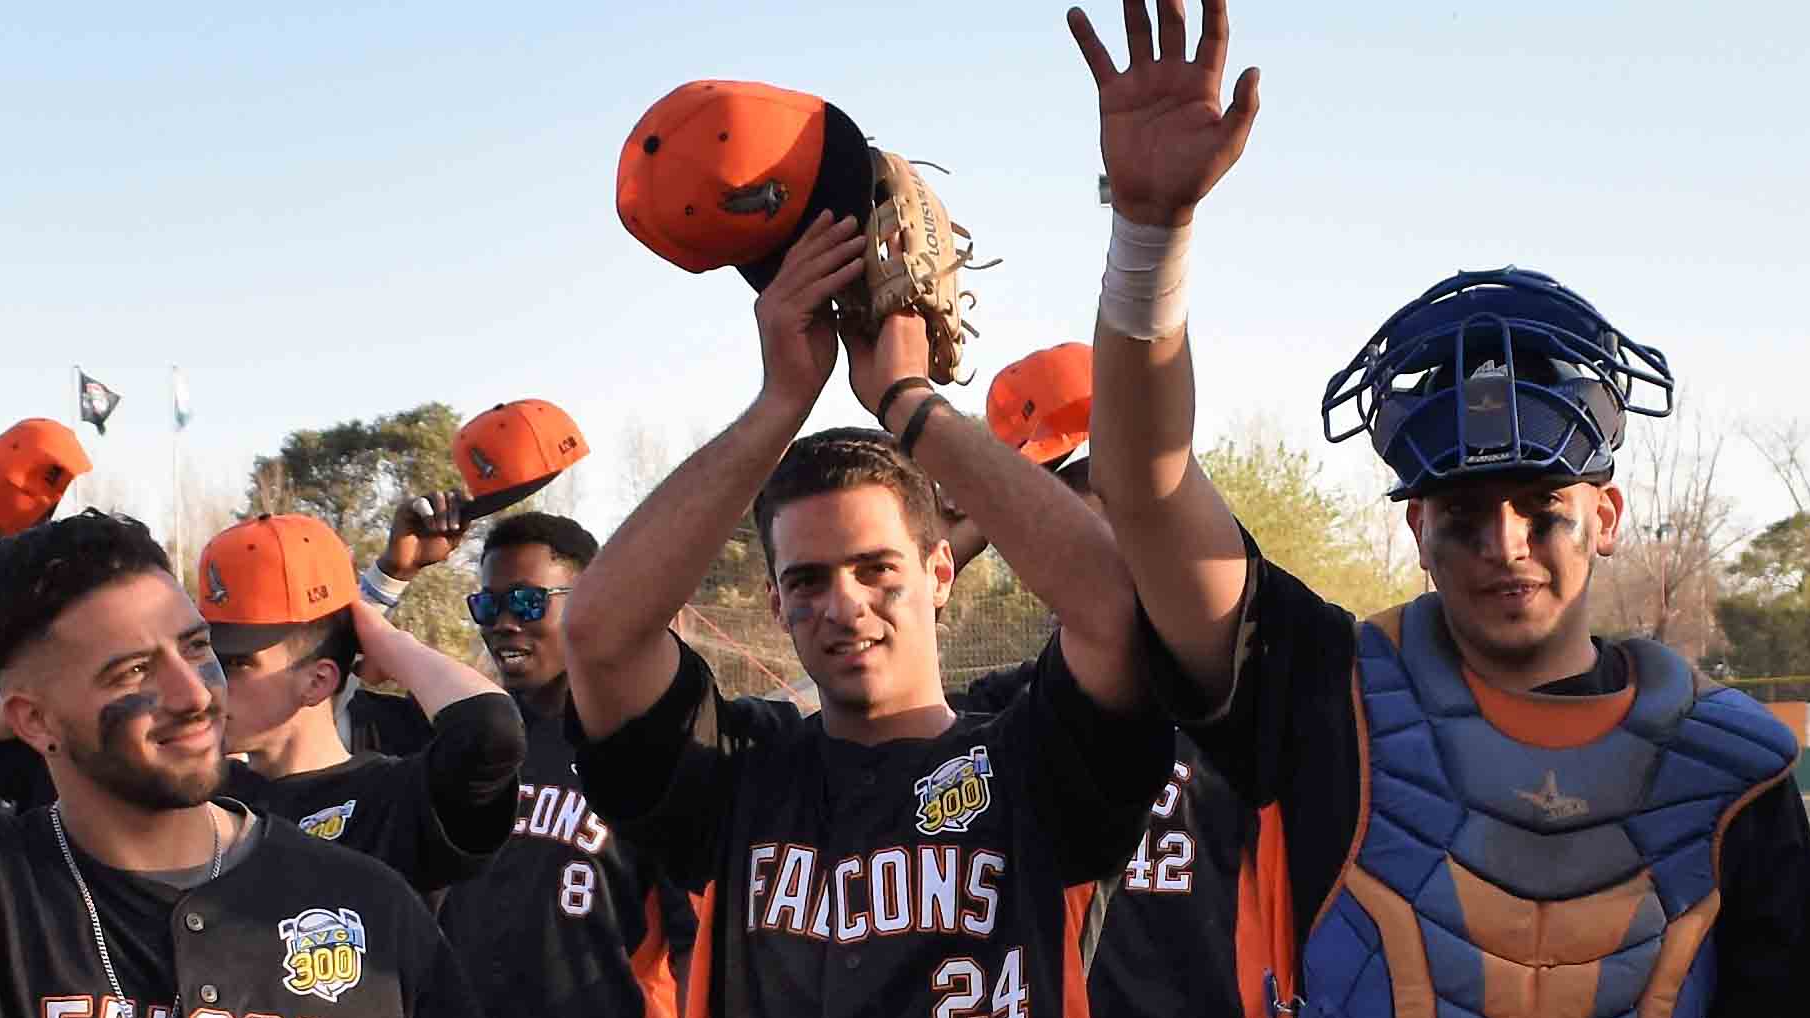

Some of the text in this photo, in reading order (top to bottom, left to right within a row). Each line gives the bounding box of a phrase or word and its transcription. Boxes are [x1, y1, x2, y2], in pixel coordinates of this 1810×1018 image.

[922, 776, 987, 831] 300
[556, 859, 596, 918] 8
[1125, 830, 1197, 893] 42
[289, 944, 357, 990] 300
